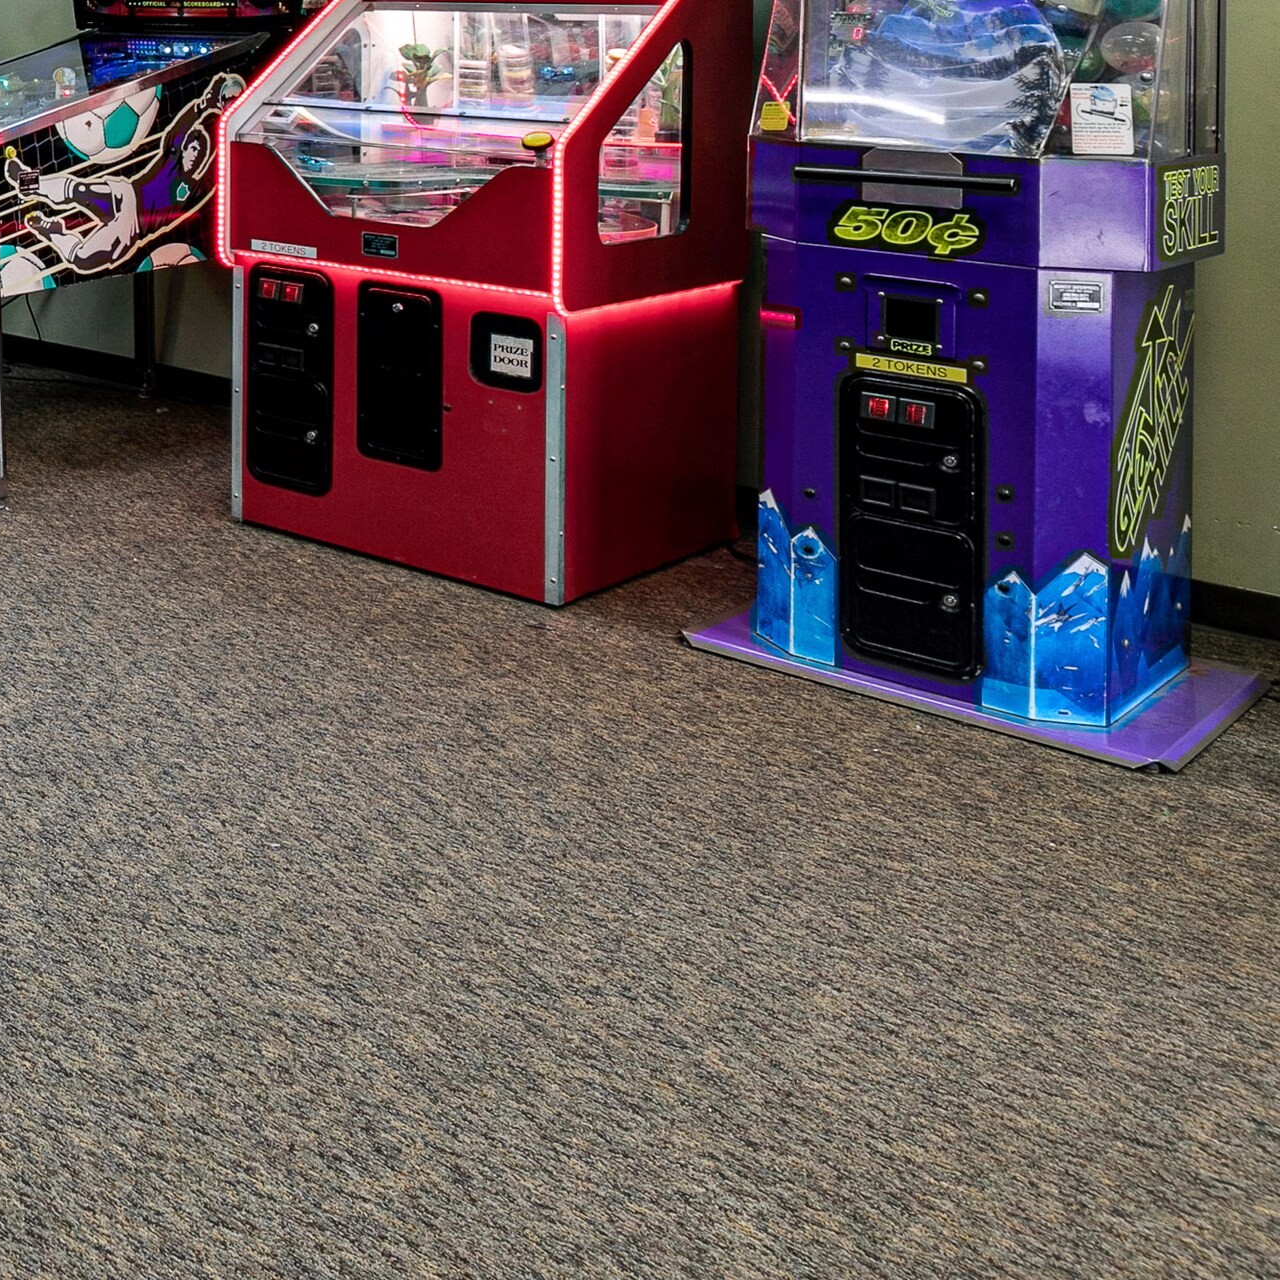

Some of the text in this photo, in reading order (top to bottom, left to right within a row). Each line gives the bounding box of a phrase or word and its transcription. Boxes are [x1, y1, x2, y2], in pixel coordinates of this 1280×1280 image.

[1164, 165, 1220, 200] TEST YOUR
[834, 206, 980, 255] 50¢
[1162, 194, 1219, 257] SKILL
[270, 243, 306, 256] TOKENS
[493, 343, 530, 357] PRIZE
[891, 339, 932, 355] PRIZE
[493, 355, 529, 368] DOOR
[884, 359, 948, 378] TOKENS
